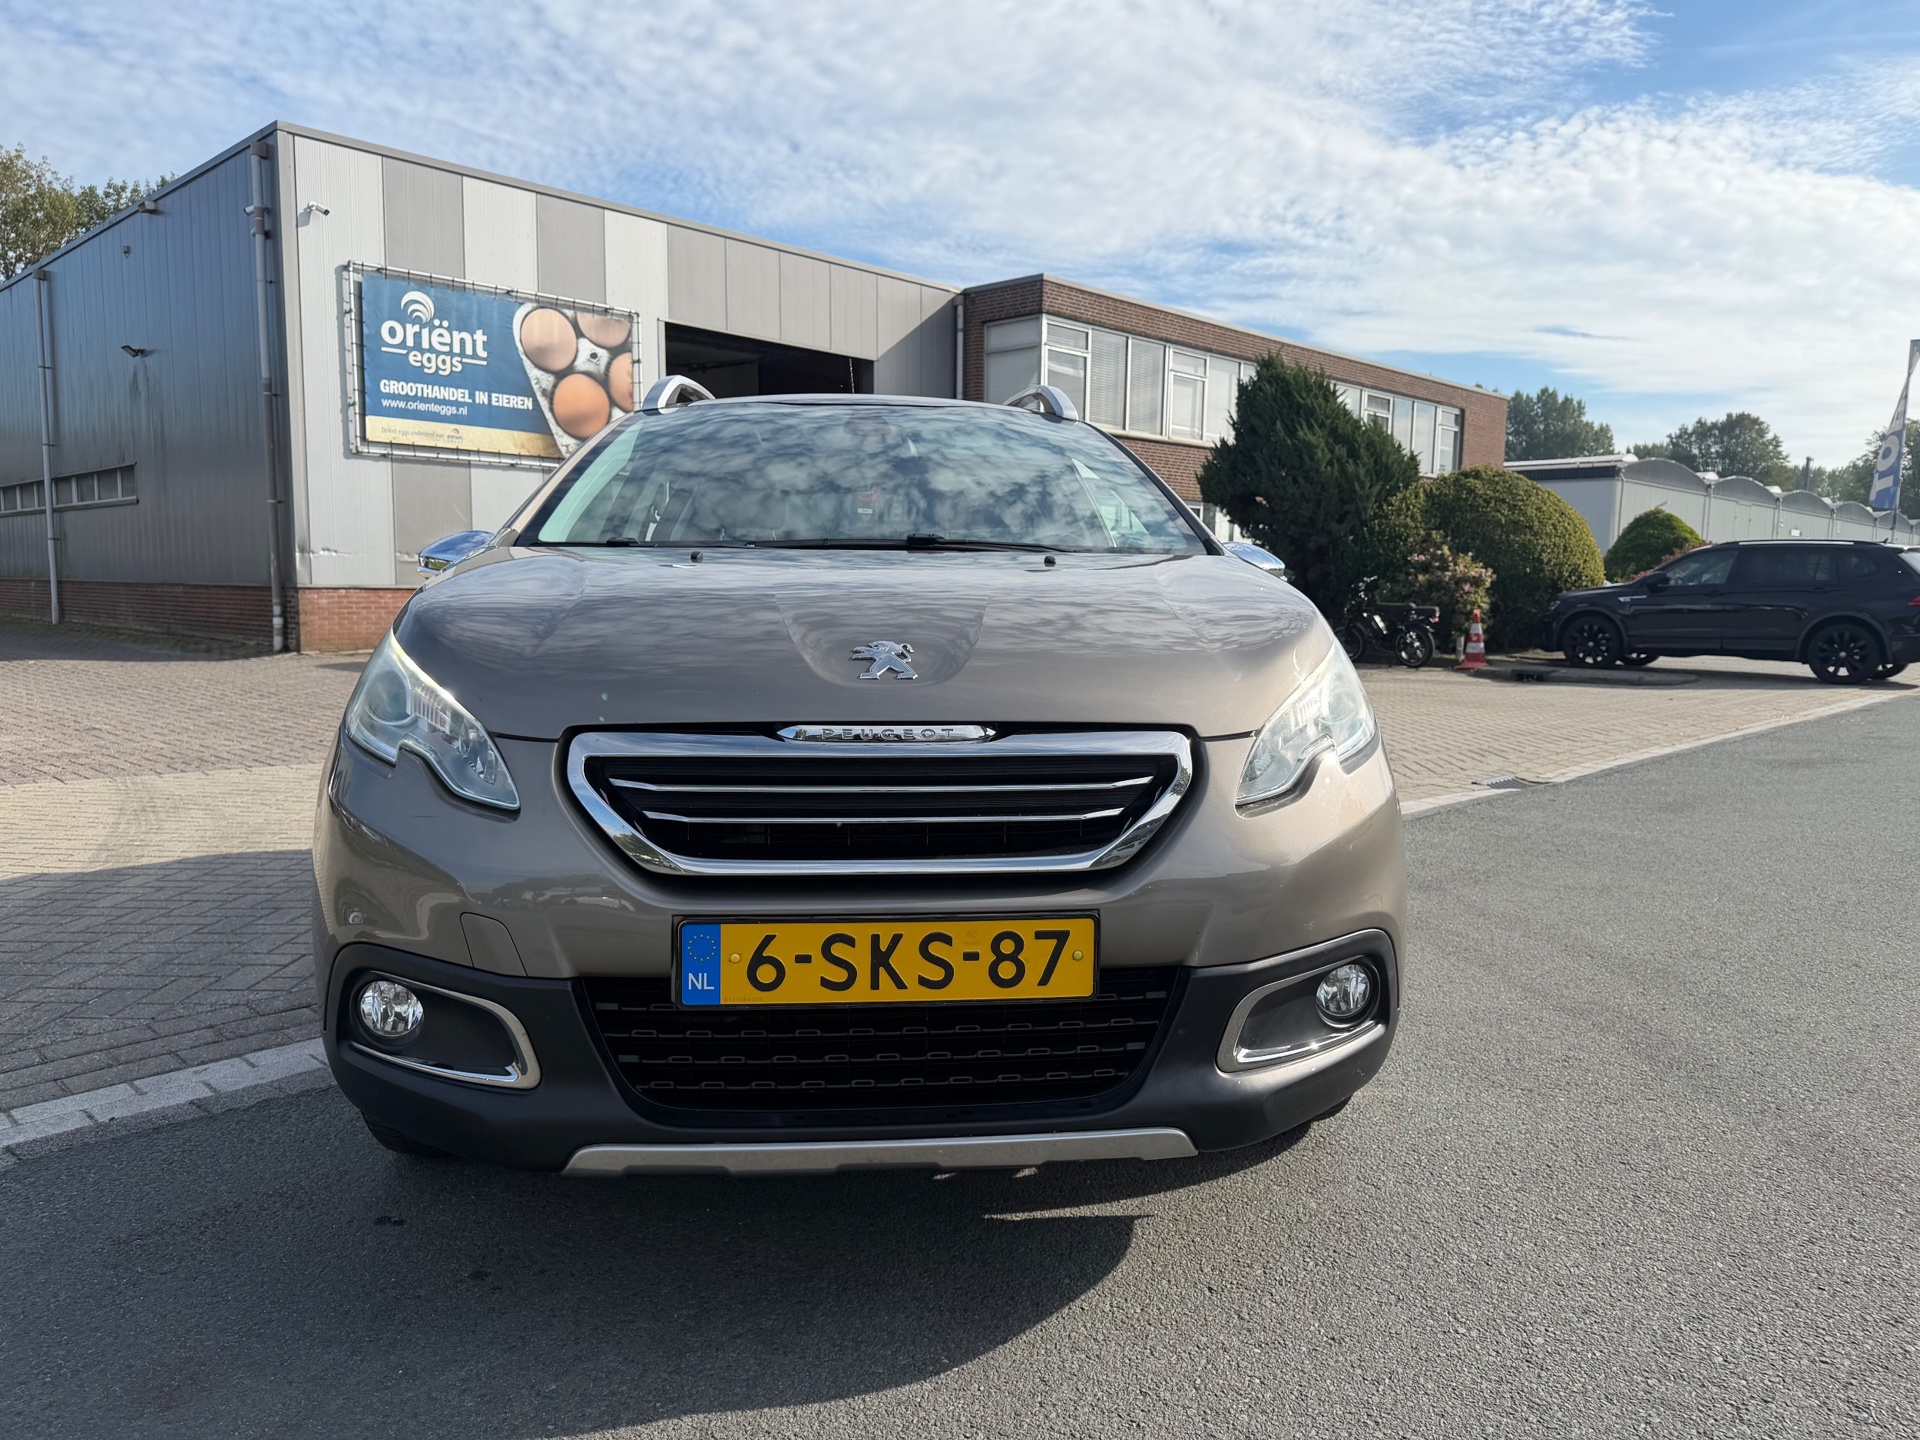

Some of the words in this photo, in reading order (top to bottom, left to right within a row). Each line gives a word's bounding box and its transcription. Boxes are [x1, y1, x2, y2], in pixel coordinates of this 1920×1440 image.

[380, 318, 488, 358] oriënt
[408, 350, 463, 376] eggs
[379, 378, 473, 403] GROOTHANDEL
[475, 390, 489, 405] IN
[491, 392, 534, 411] EIEREN
[381, 398, 468, 416] www.orienteggs.nl
[821, 728, 954, 741] PEUGEOT
[745, 929, 1071, 992] 6-SKS-87
[687, 973, 715, 990] NL
